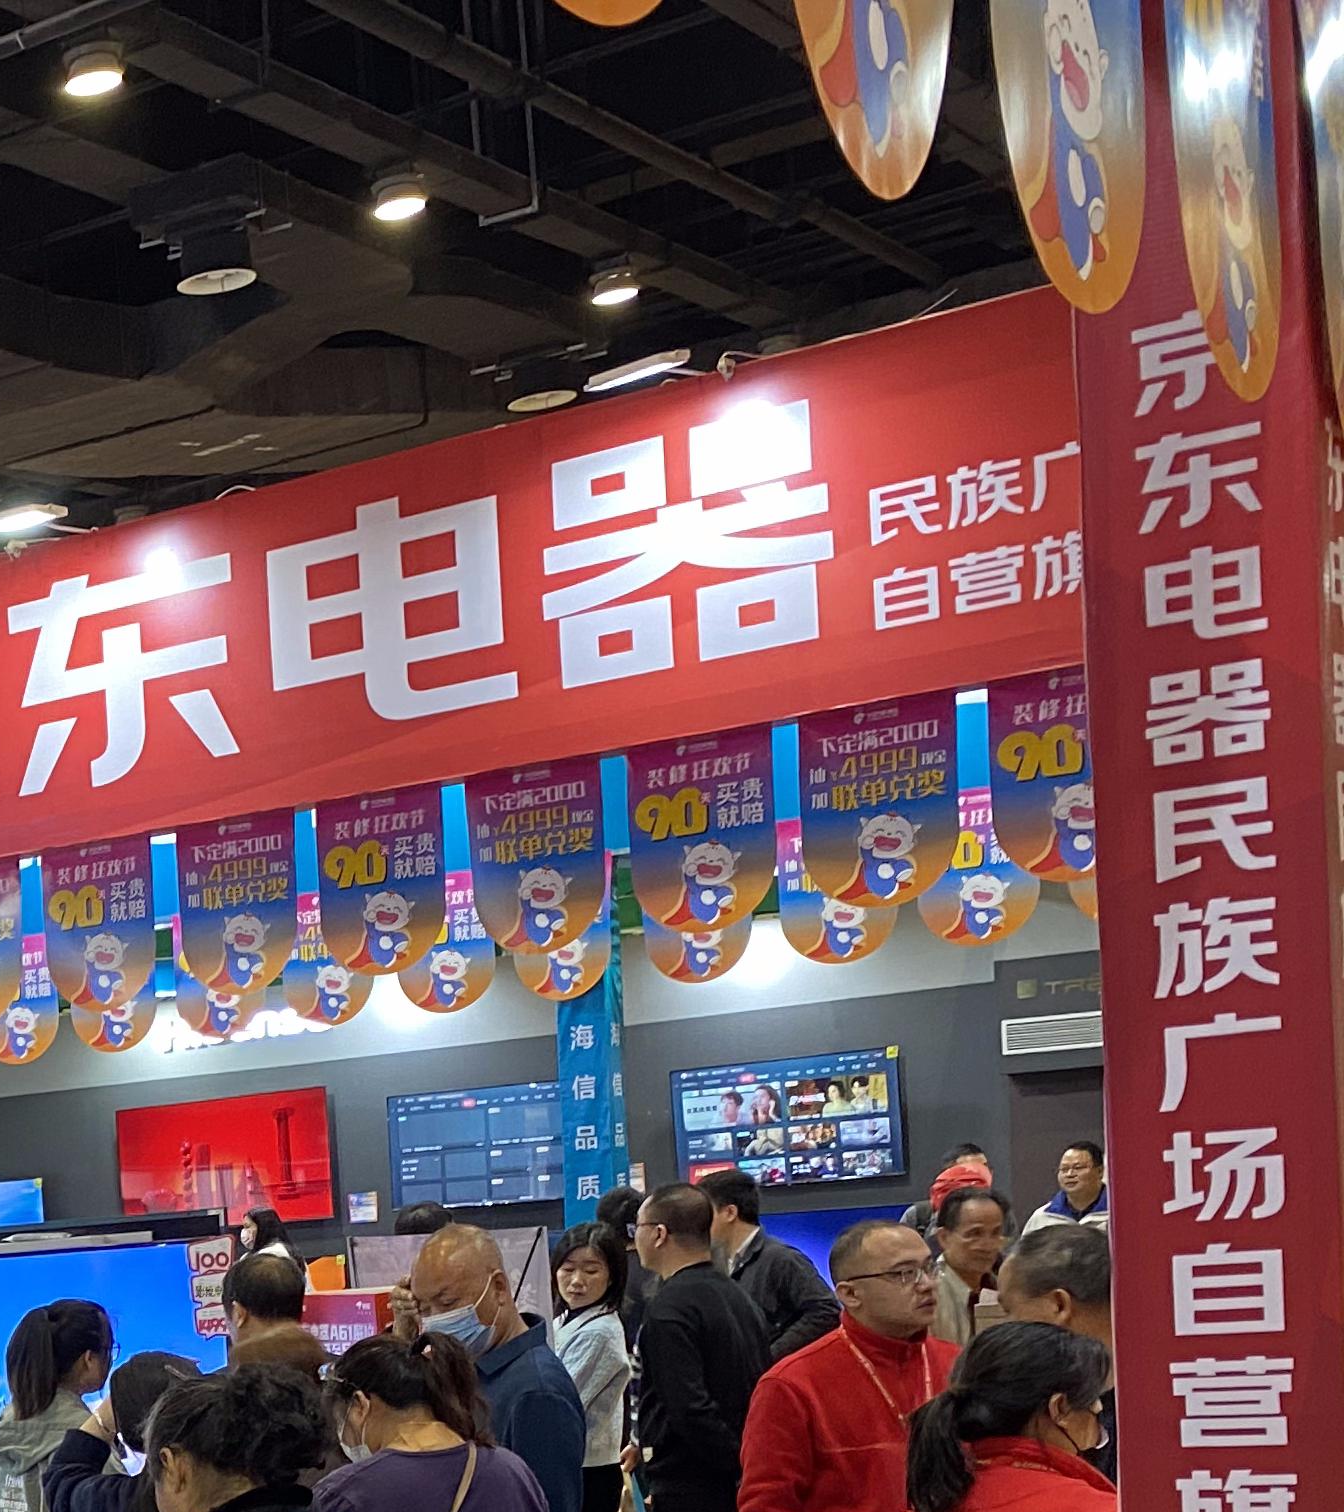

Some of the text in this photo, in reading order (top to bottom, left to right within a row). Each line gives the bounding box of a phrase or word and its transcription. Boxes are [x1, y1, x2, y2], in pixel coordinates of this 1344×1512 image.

[868, 440, 1081, 546] 民族广
[816, 718, 939, 758] 下定满2000
[647, 751, 752, 790] 装修狂欢节
[481, 779, 586, 815] 下定满2000
[716, 778, 764, 807] 买贵
[334, 808, 427, 841] 装修狂欢节
[716, 803, 765, 829] 就赔
[191, 833, 283, 864] 下定满2000
[393, 832, 437, 857] 买贵
[393, 856, 437, 881] 就赔
[110, 877, 146, 901] 买贵
[110, 898, 147, 923] 就赔
[569, 1024, 601, 1201] 海信品质
